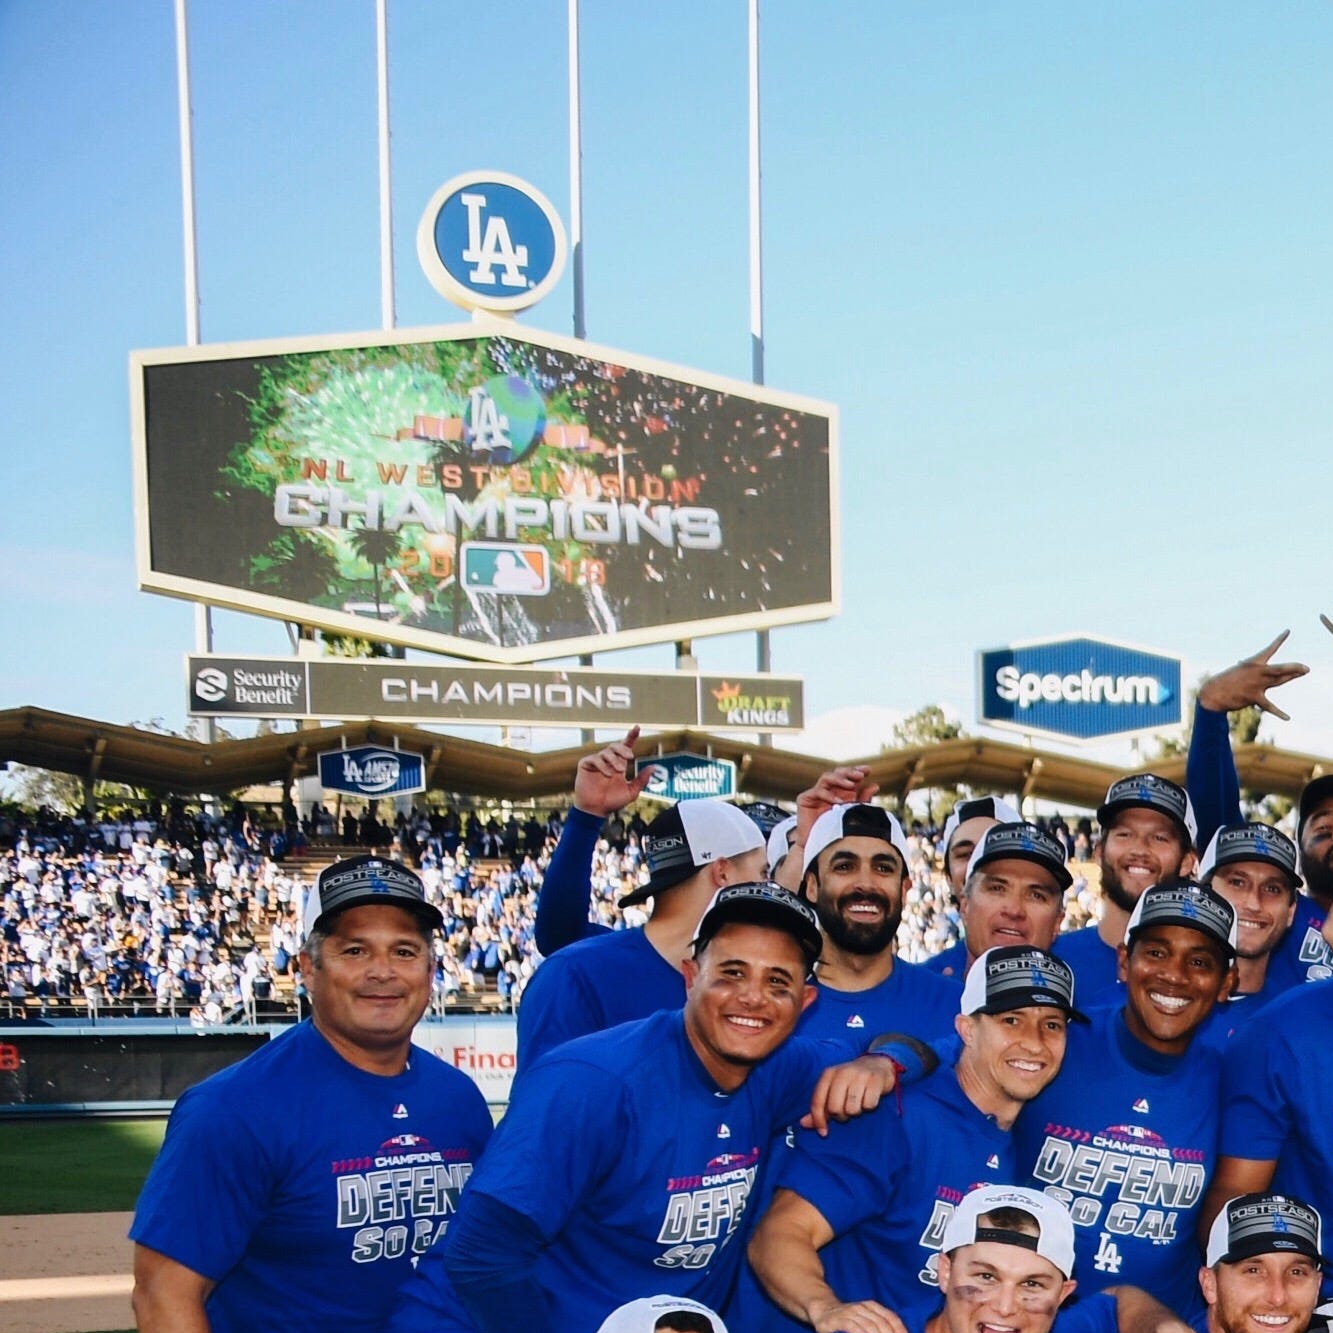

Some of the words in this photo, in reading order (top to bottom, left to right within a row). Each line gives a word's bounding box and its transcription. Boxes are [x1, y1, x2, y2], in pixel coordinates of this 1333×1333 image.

[461, 192, 528, 286] LA
[303, 459, 354, 482] NL
[376, 462, 482, 492] WEST
[509, 470, 701, 502] DIVISION
[272, 482, 723, 551] CHAMPIONS
[233, 668, 301, 688] Security
[996, 665, 1159, 708] Spectrum
[234, 686, 294, 704] Benefit
[381, 677, 632, 710] CHAMPIONS
[718, 696, 791, 713] DRAFT
[726, 709, 790, 725] KINGS
[673, 764, 725, 782] Security
[453, 1046, 515, 1070] Fina
[374, 1151, 444, 1168] CHAMPIONS
[1092, 1135, 1172, 1159] CHAMPIONS
[1032, 1135, 1206, 1210] DEFEND
[1104, 1198, 1178, 1242] CAL
[351, 1225, 408, 1264] SO
[653, 1243, 716, 1270] SO
[1093, 1232, 1123, 1274] LA
